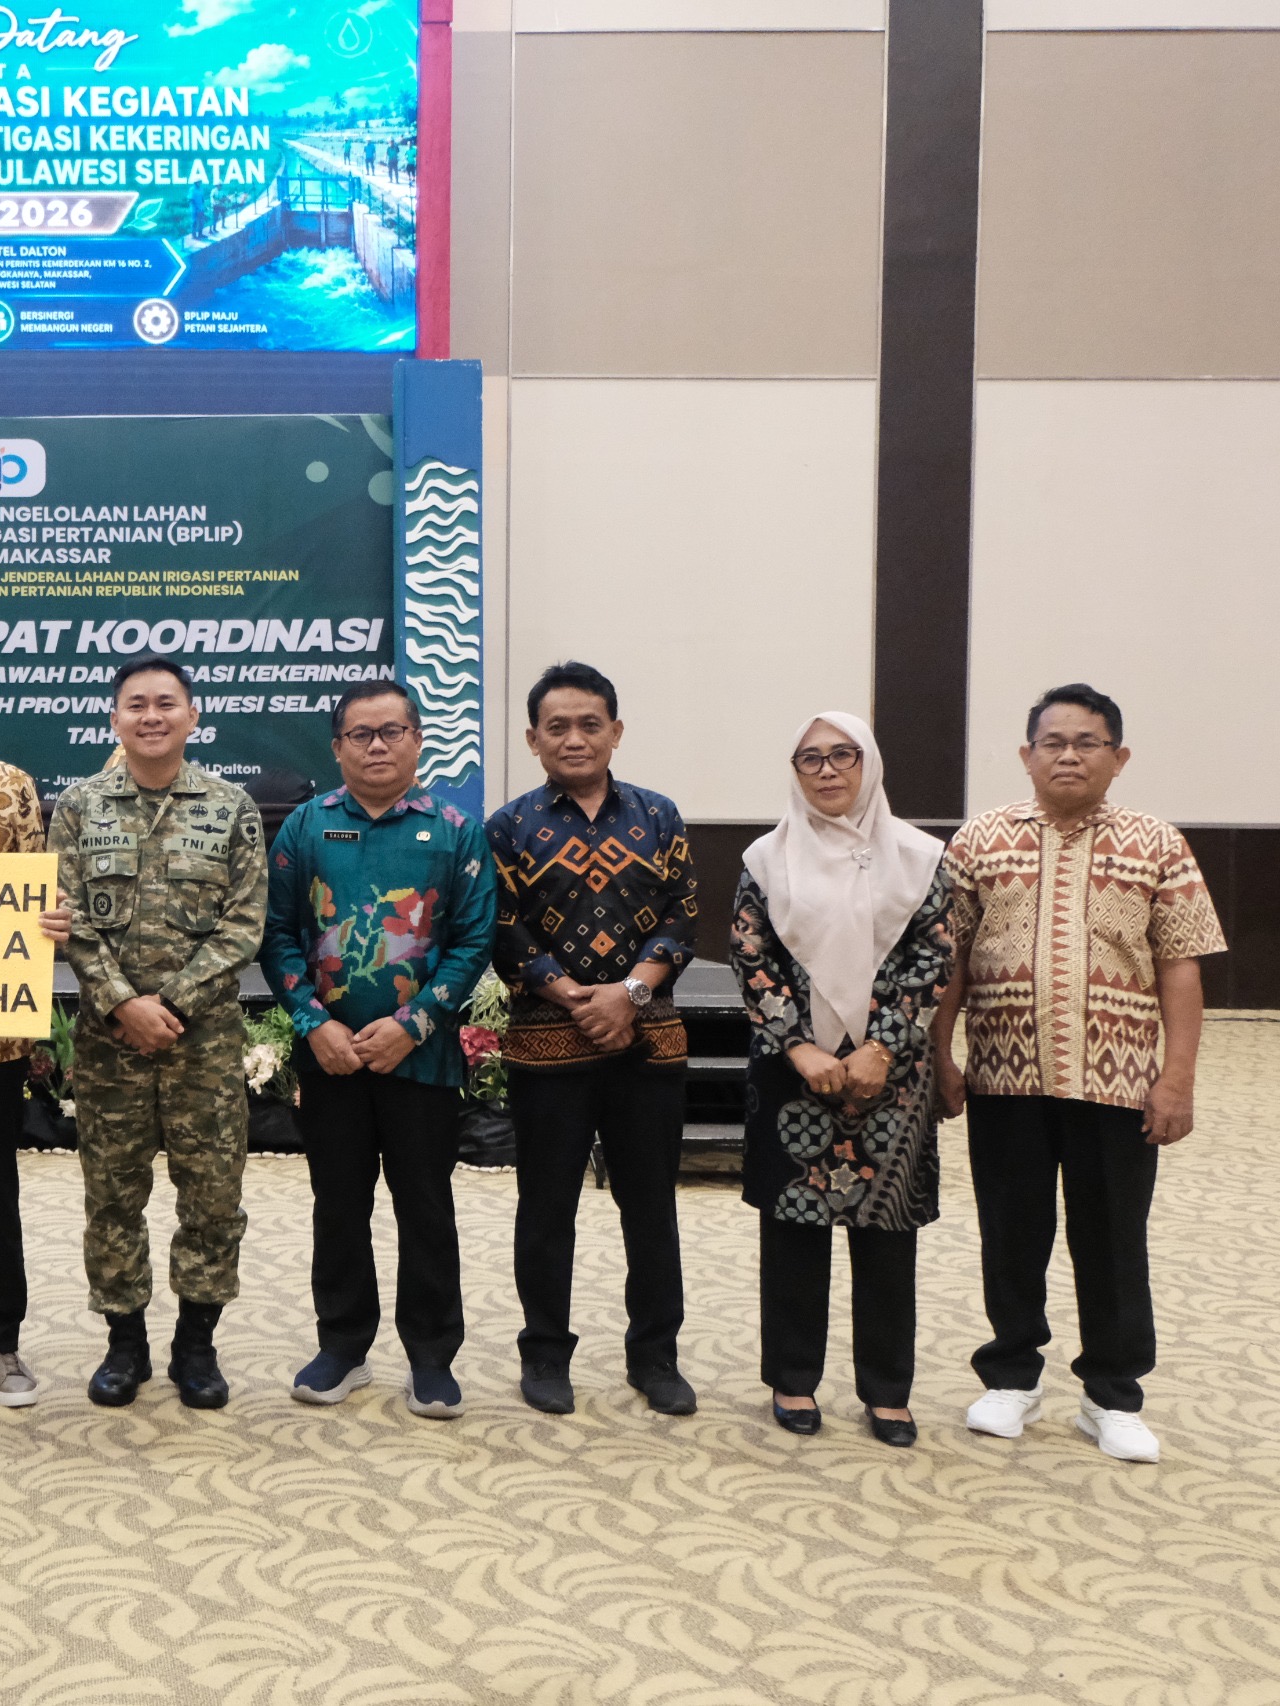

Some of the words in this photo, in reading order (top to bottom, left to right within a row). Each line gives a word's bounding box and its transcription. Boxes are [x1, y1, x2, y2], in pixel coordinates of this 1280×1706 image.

[64, 86, 249, 118] KEGIATAN
[90, 125, 270, 151] KEKERINGAN
[135, 159, 265, 184] SELATAN
[20, 246, 66, 257] DALTON
[6, 260, 40, 268] PERINTIS
[42, 259, 101, 268] KEMERDEKAAN
[103, 259, 116, 268] KM
[118, 259, 126, 268] 16
[128, 259, 143, 268] NO.
[44, 270, 92, 279] MAKASSAR,
[21, 281, 56, 289] SELATAN
[20, 311, 74, 321] BERSINERGI
[184, 311, 210, 321] BPLIP
[212, 311, 238, 321] MAJU
[20, 323, 79, 333] MEMBANGUN
[81, 323, 113, 333] NEGERI
[184, 323, 216, 333] PETANI
[218, 323, 268, 333] SEJAHTERA
[133, 506, 207, 522] LAHAN
[42, 527, 163, 543] PERTANIAN
[167, 521, 243, 546] (BPLIP)
[1, 572, 72, 583] JENDERAL
[75, 572, 124, 582] LAHAN
[127, 572, 159, 582] DAN
[162, 571, 215, 582] IRIGASI
[218, 571, 299, 582] PERTANIAN
[11, 585, 93, 596] PERTANIAN
[96, 585, 162, 596] REPUBLIK
[166, 585, 244, 596] INDONESIA
[77, 619, 384, 653] KOORDINASI
[268, 695, 342, 712] SELAT
[213, 764, 261, 774] Dalton
[81, 836, 130, 849] WINDRA
[181, 838, 204, 850] TNI
[211, 844, 228, 855] AD
